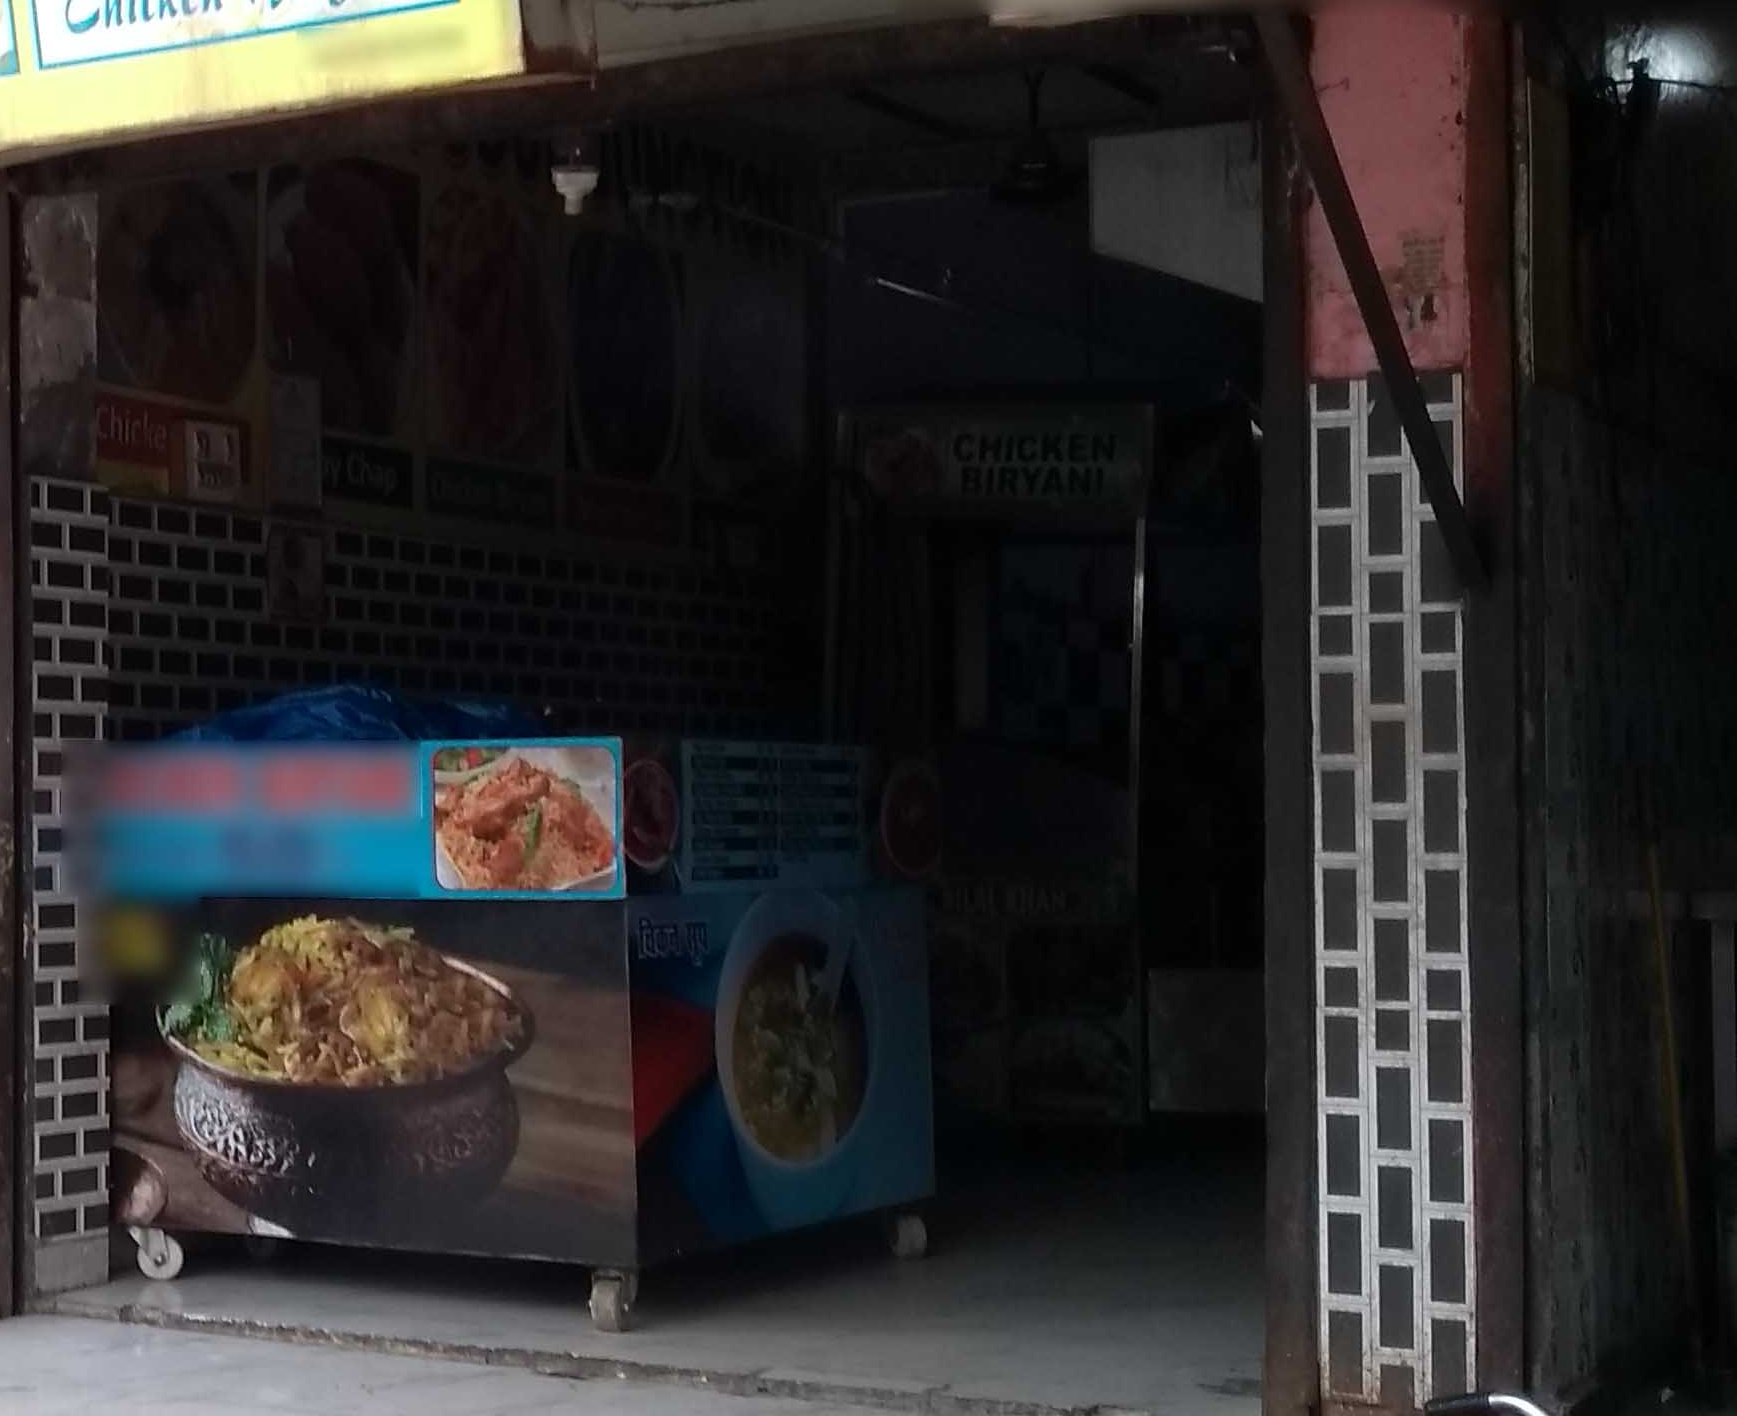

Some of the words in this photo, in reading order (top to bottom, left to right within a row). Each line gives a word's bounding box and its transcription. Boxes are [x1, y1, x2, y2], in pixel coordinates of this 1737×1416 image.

[95, 402, 169, 452] Chicke
[952, 431, 1118, 463] CHICKEN
[960, 465, 1105, 496] BIRYANI
